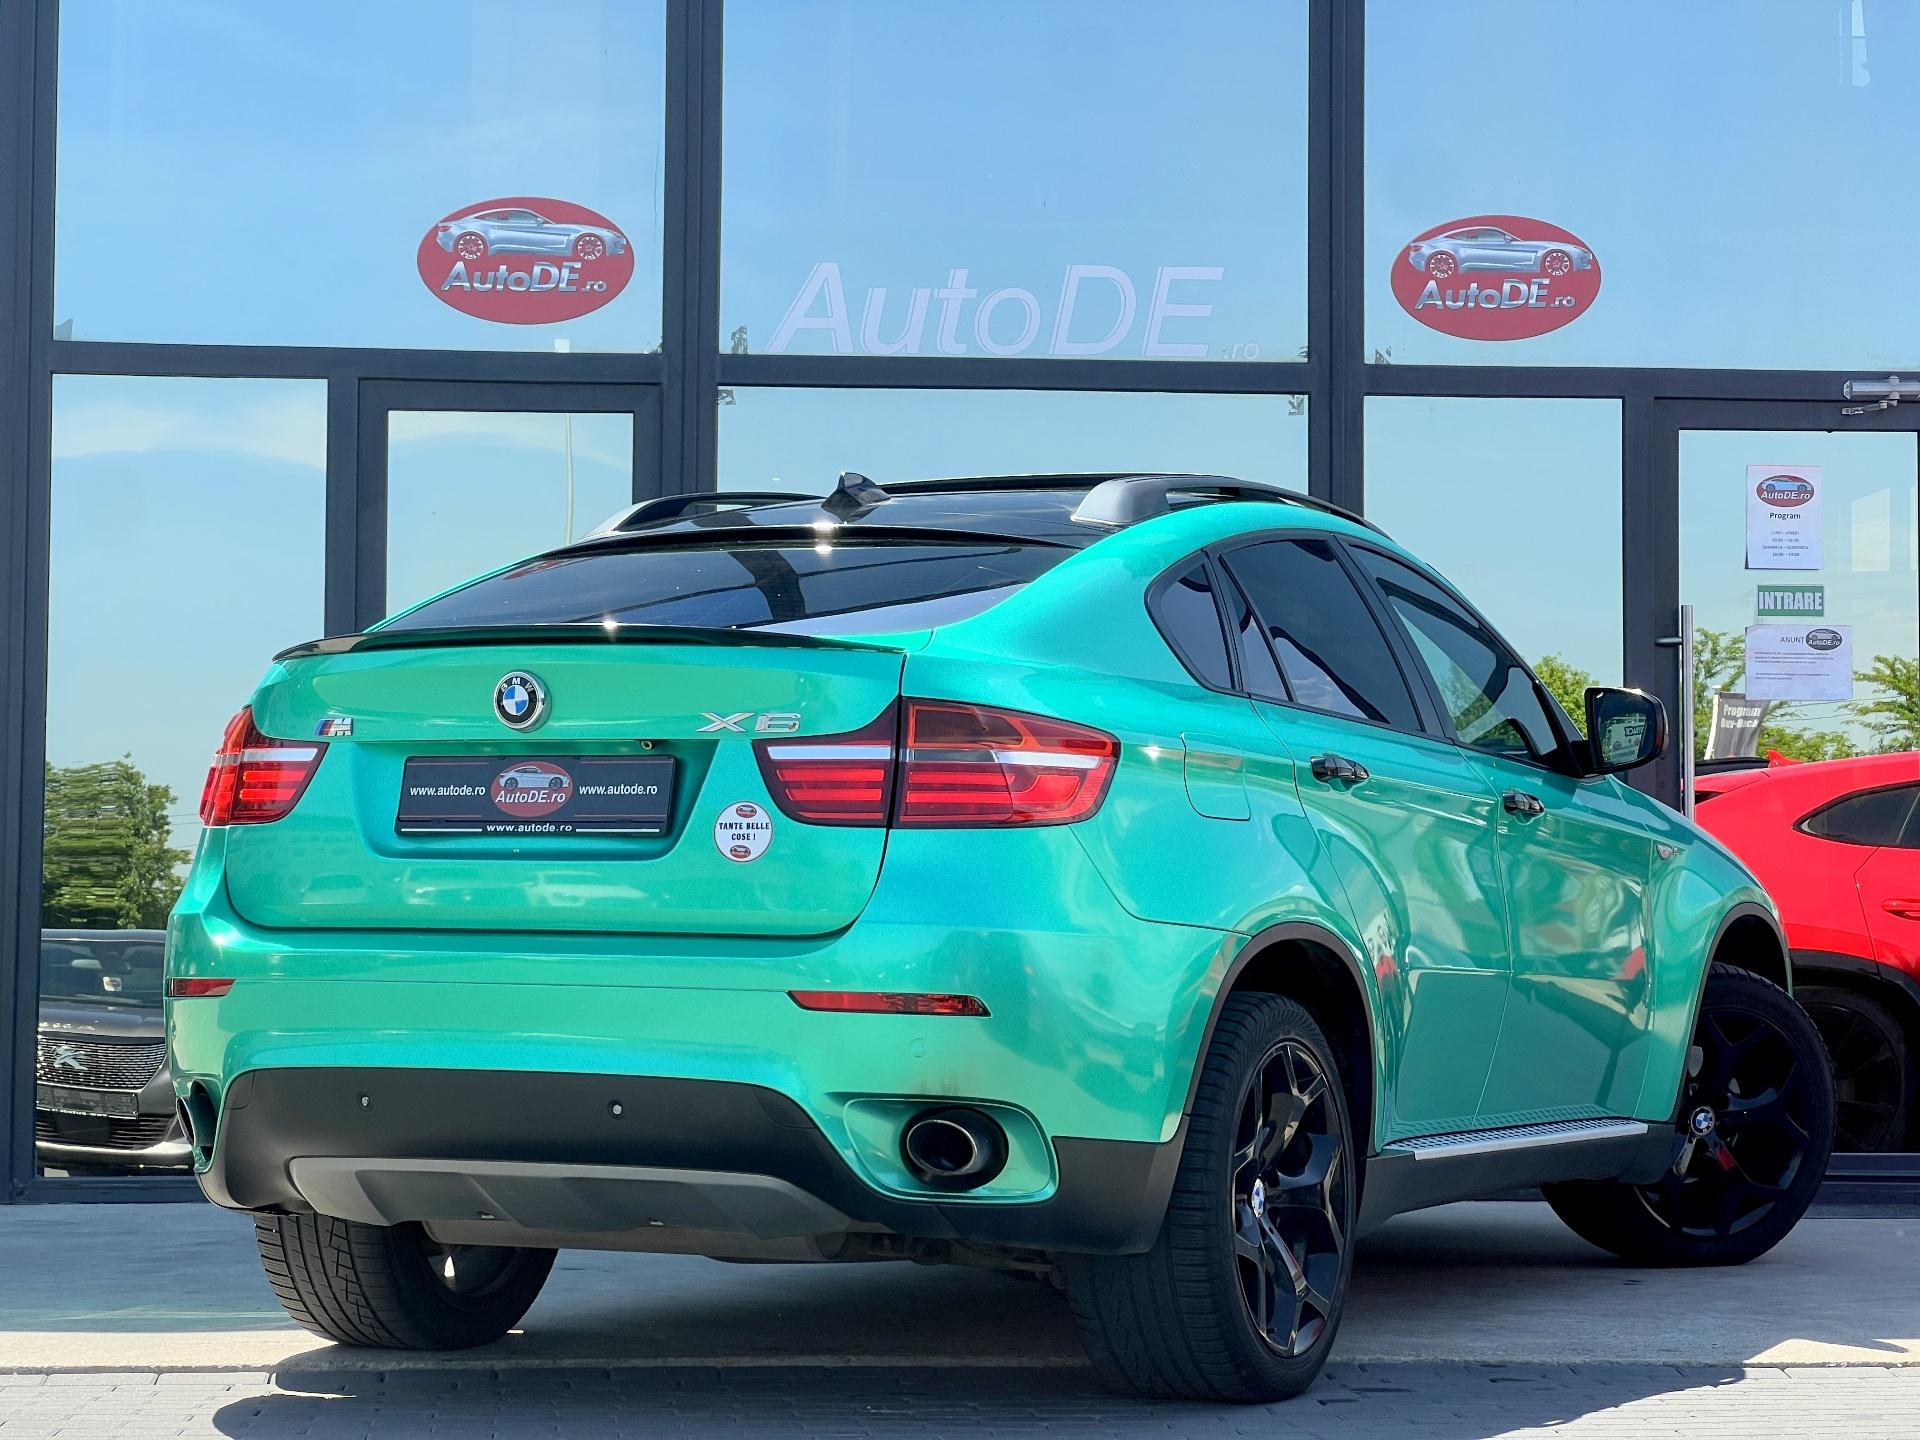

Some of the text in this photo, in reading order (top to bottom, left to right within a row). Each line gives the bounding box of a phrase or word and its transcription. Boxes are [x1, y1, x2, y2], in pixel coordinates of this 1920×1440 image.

[1760, 491, 1811, 500] AutoDE.ro
[1769, 512, 1801, 520] Program
[1759, 592, 1823, 610] INTRARE
[500, 677, 535, 693] BMW
[696, 712, 802, 733] X6
[410, 784, 486, 796] www.autode.ro
[579, 783, 658, 795] www.autode.ro
[495, 790, 566, 804] AutoDE.ro
[486, 823, 573, 833] www.autode.ro
[718, 822, 770, 830] TANTE BELLE
[731, 833, 751, 841] COSE
